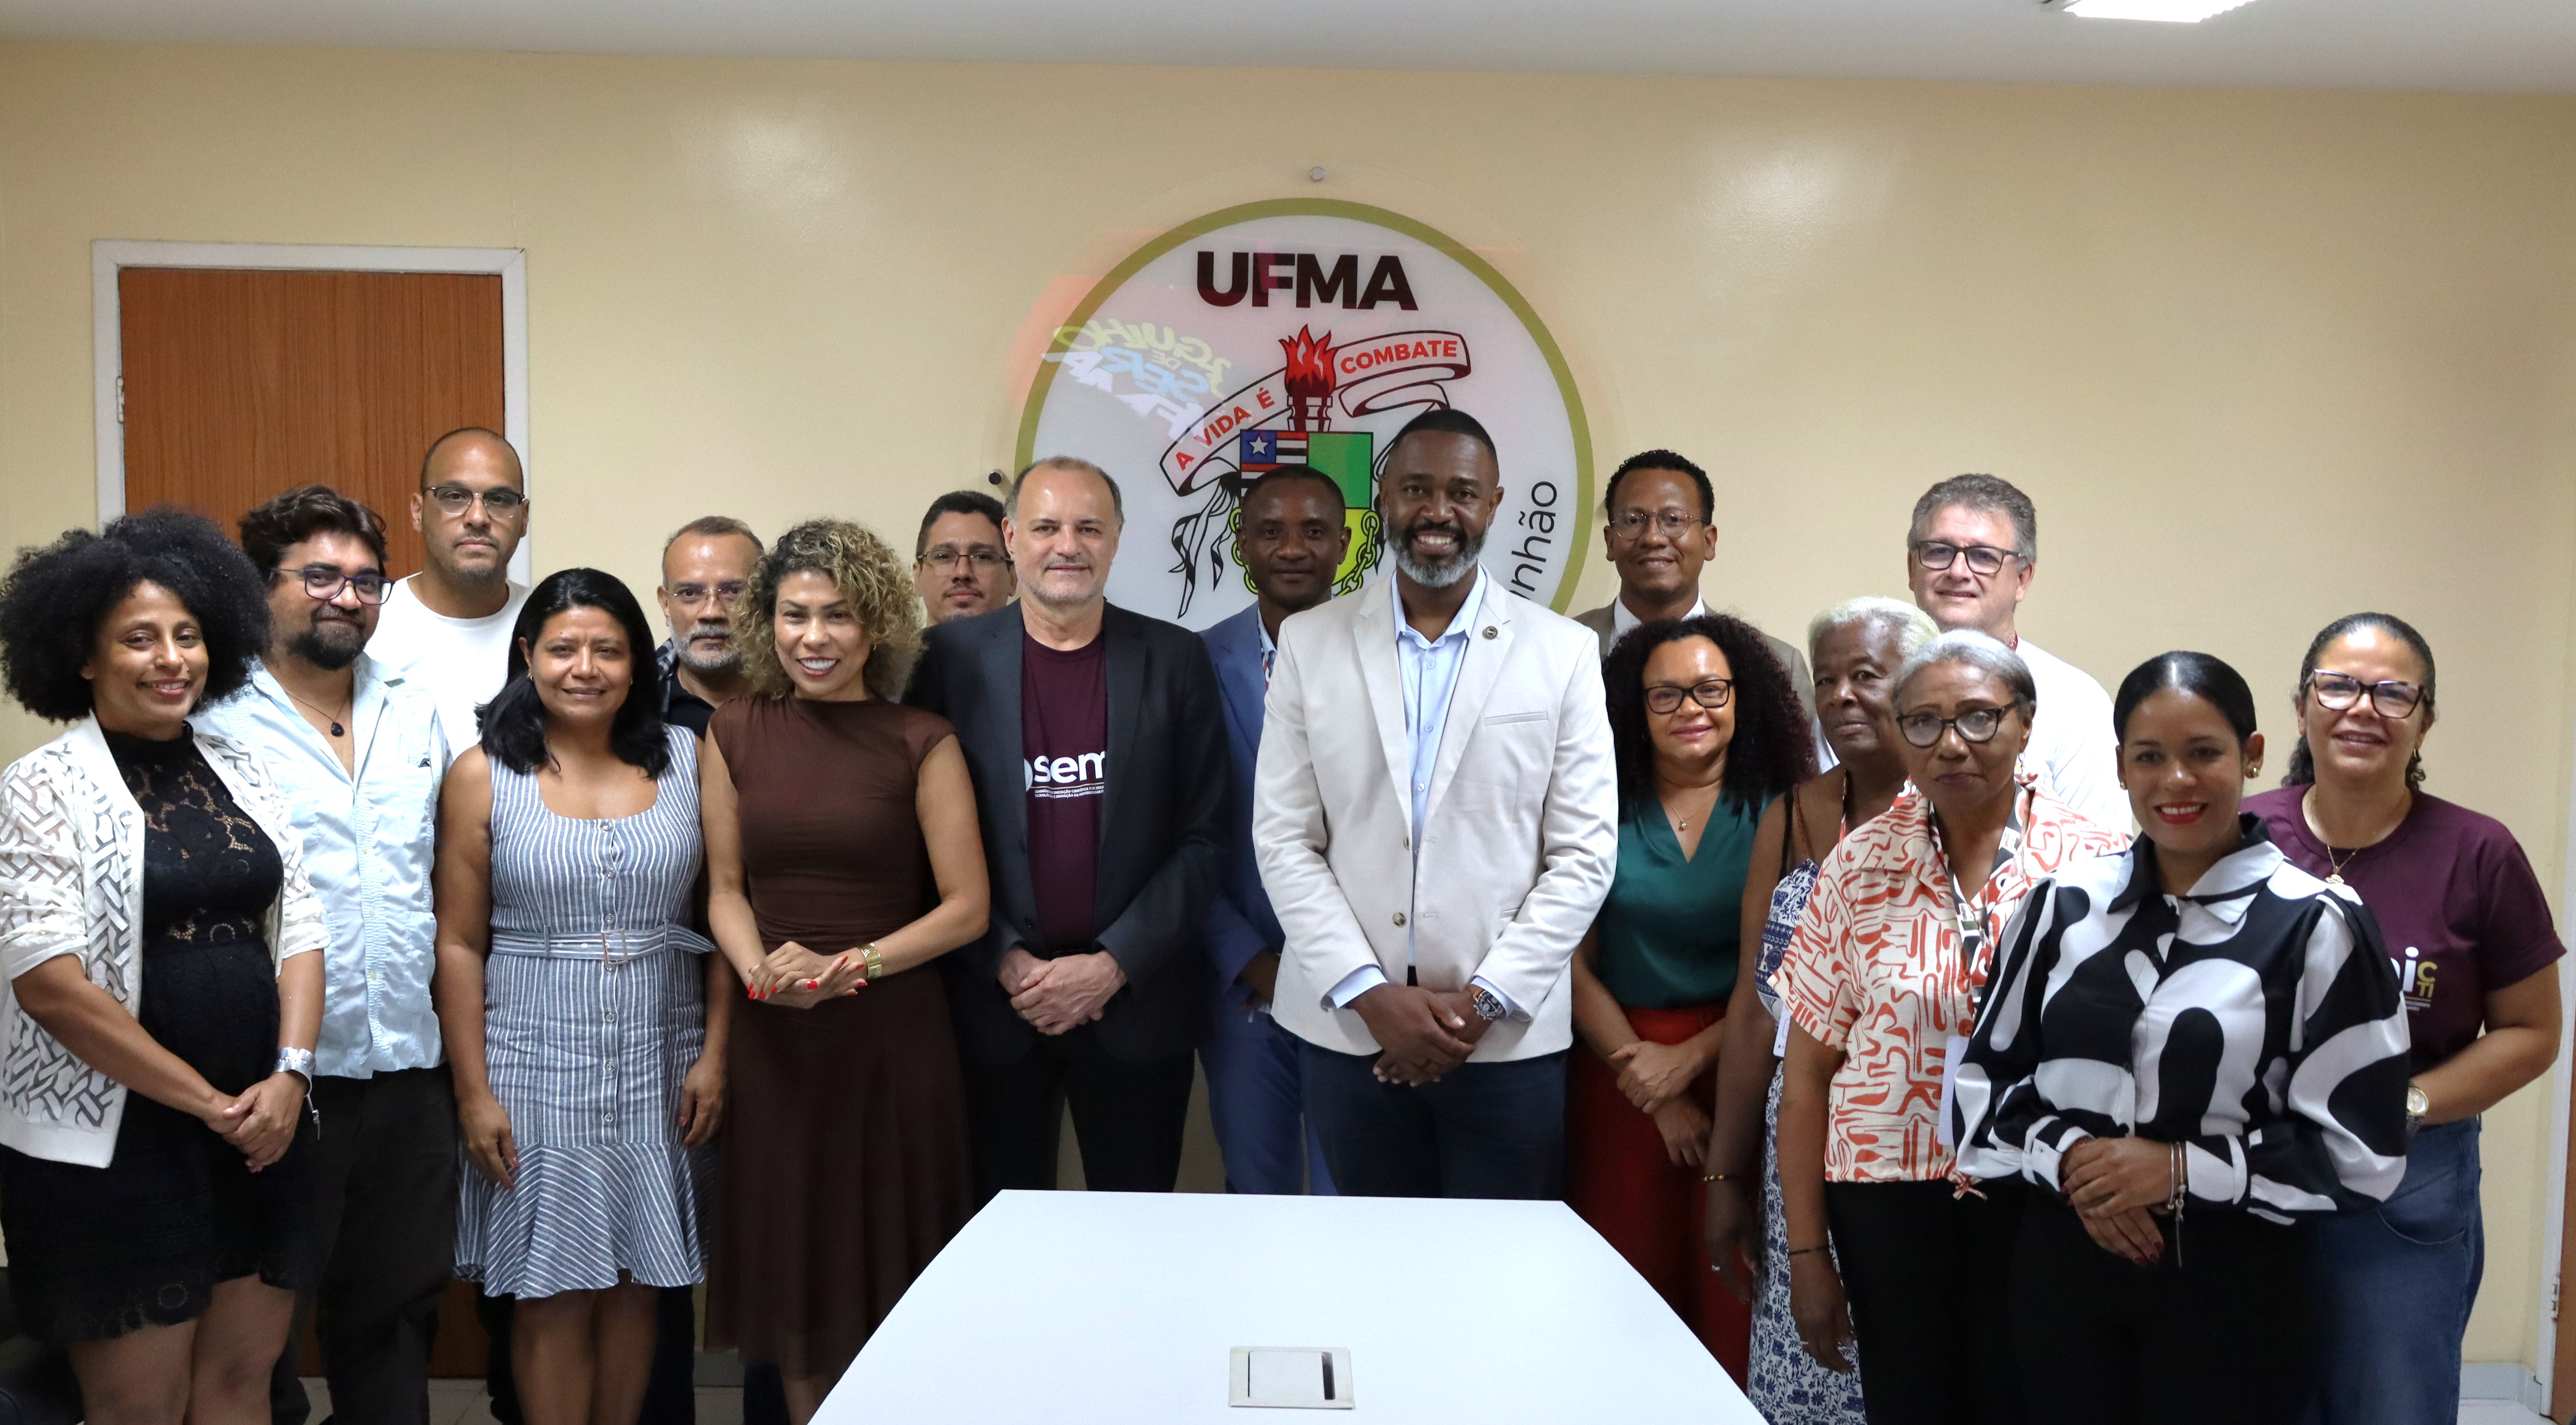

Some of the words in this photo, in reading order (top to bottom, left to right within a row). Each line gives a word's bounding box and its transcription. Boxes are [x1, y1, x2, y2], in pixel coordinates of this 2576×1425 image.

[1197, 251, 1419, 311] UFMA
[1176, 452, 1195, 471] A
[1194, 406, 1252, 446] VIDA
[1256, 387, 1275, 410] É
[1341, 340, 1457, 373] COMBATE
[1509, 481, 1557, 600] nhão
